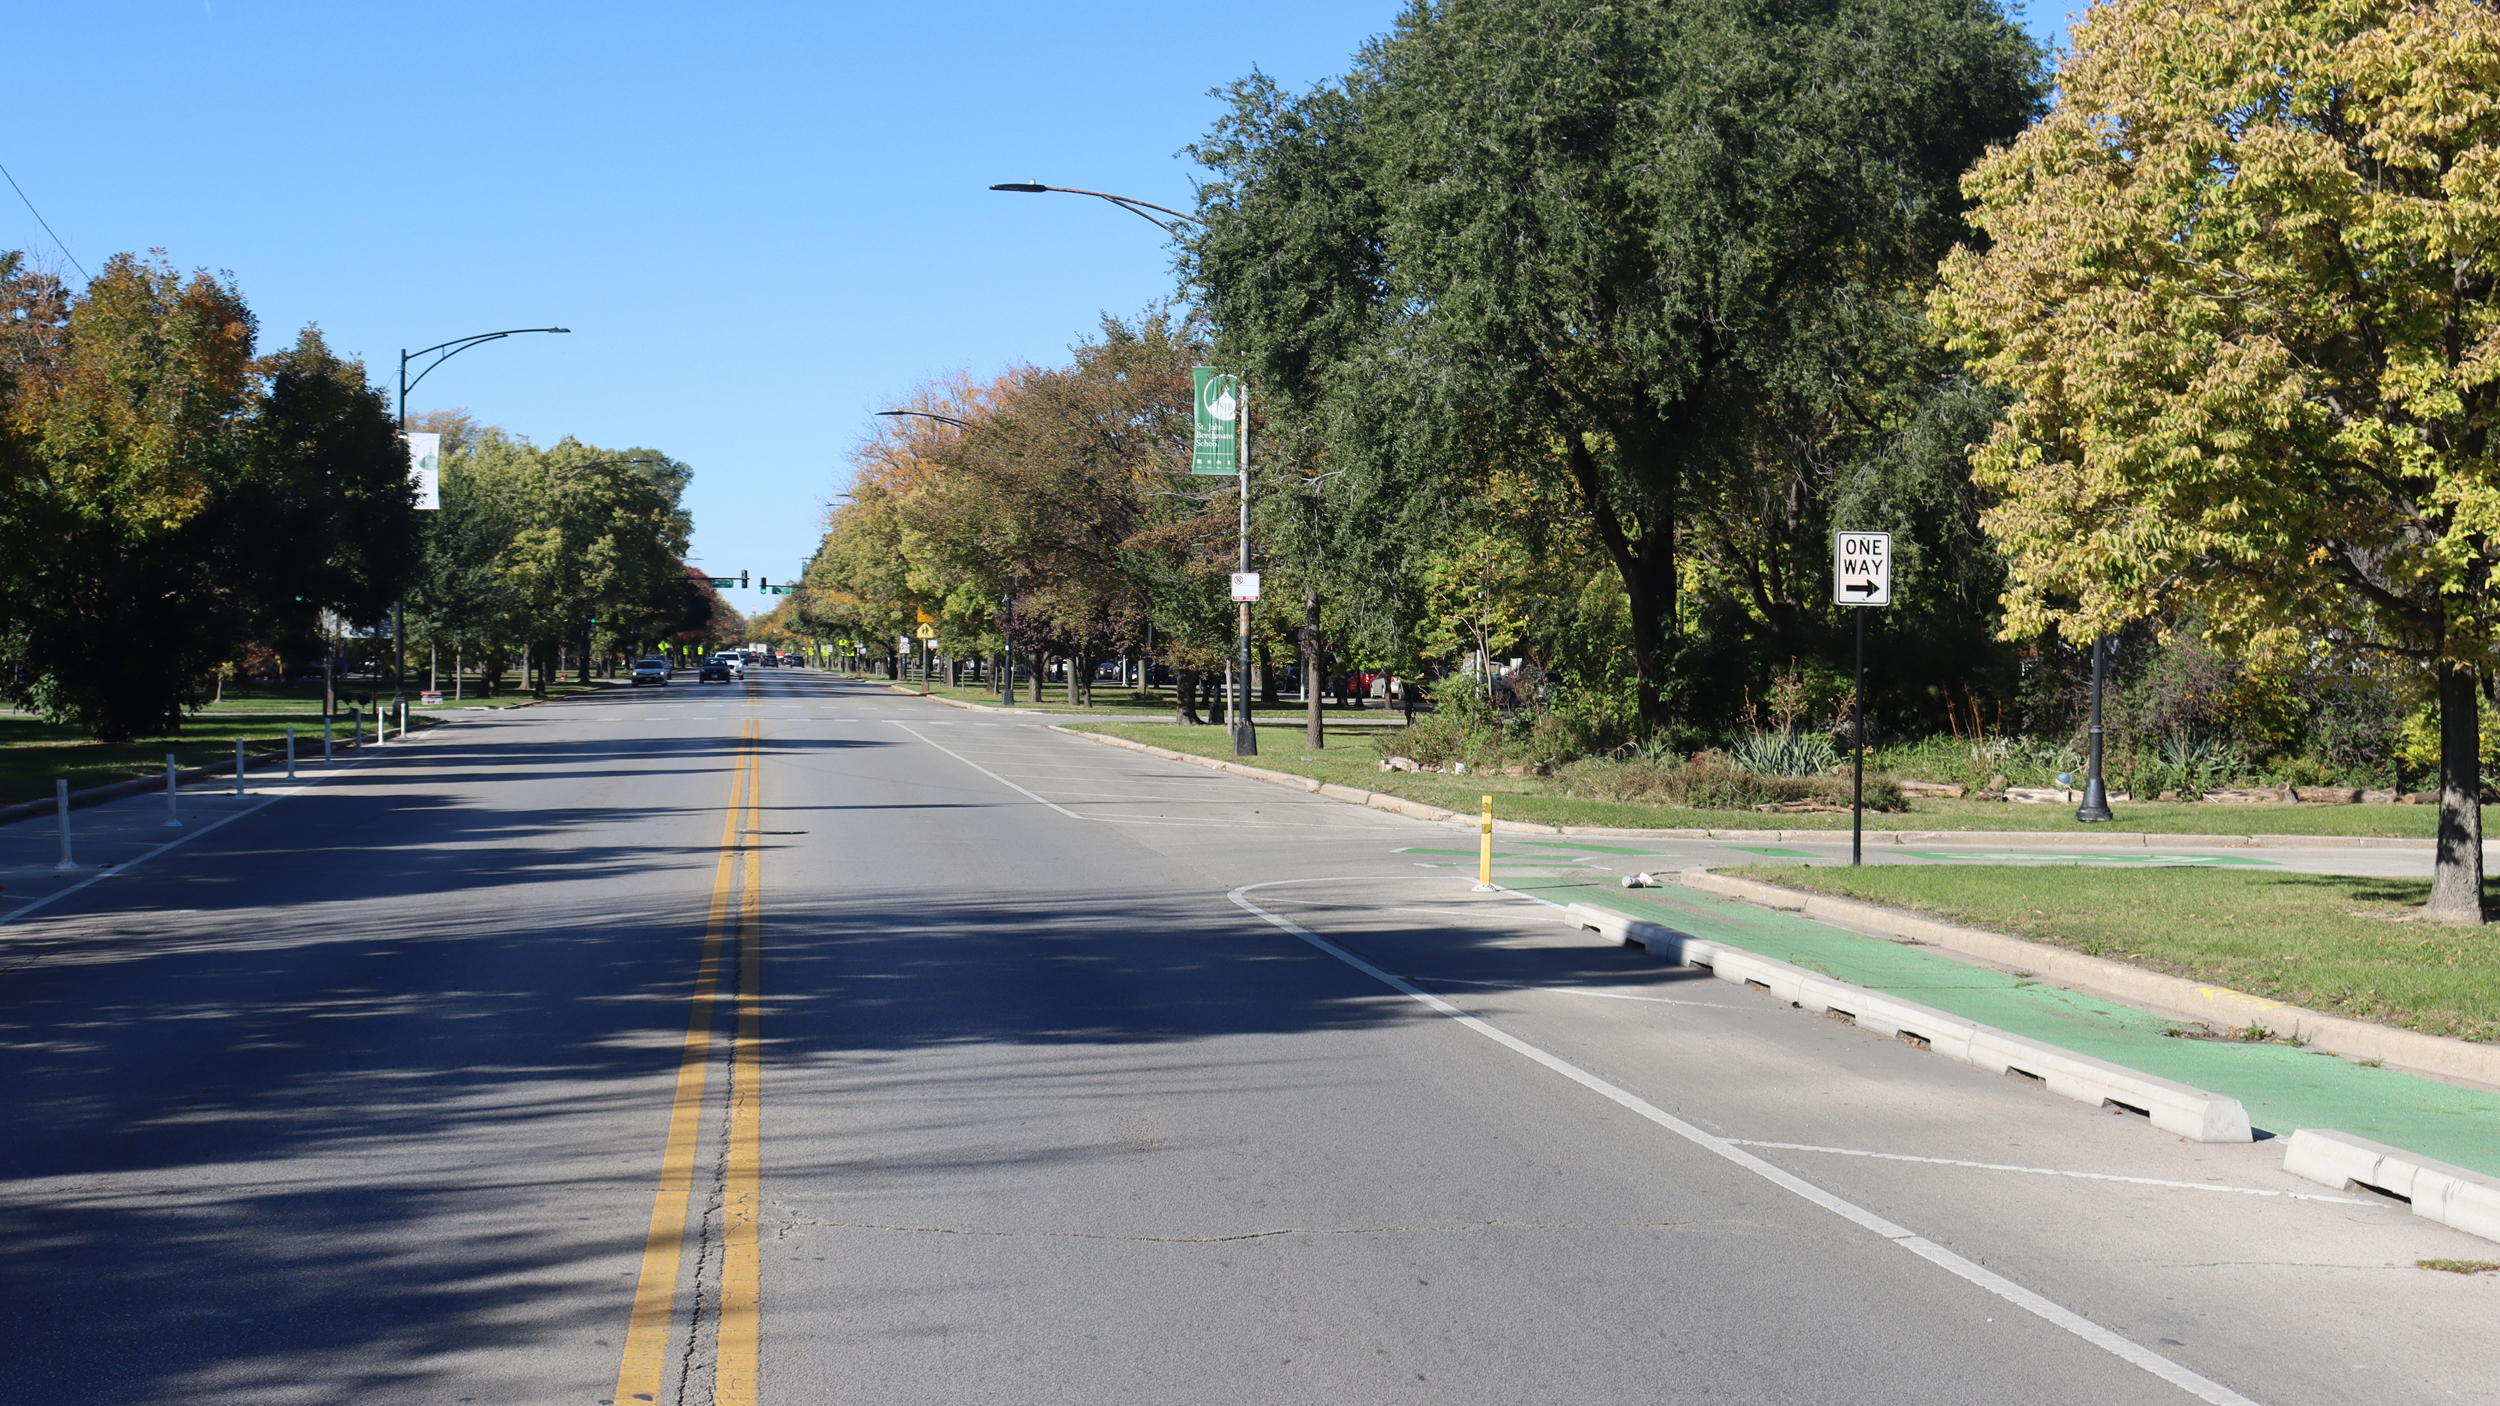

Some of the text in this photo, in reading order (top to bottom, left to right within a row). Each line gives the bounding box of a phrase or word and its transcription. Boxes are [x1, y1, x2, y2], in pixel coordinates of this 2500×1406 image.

[1208, 423, 1224, 432] John
[1196, 431, 1234, 439] Berchmans
[1196, 439, 1219, 447] Schoo
[1845, 538, 1882, 556] ONE
[1843, 558, 1884, 576] WAY
